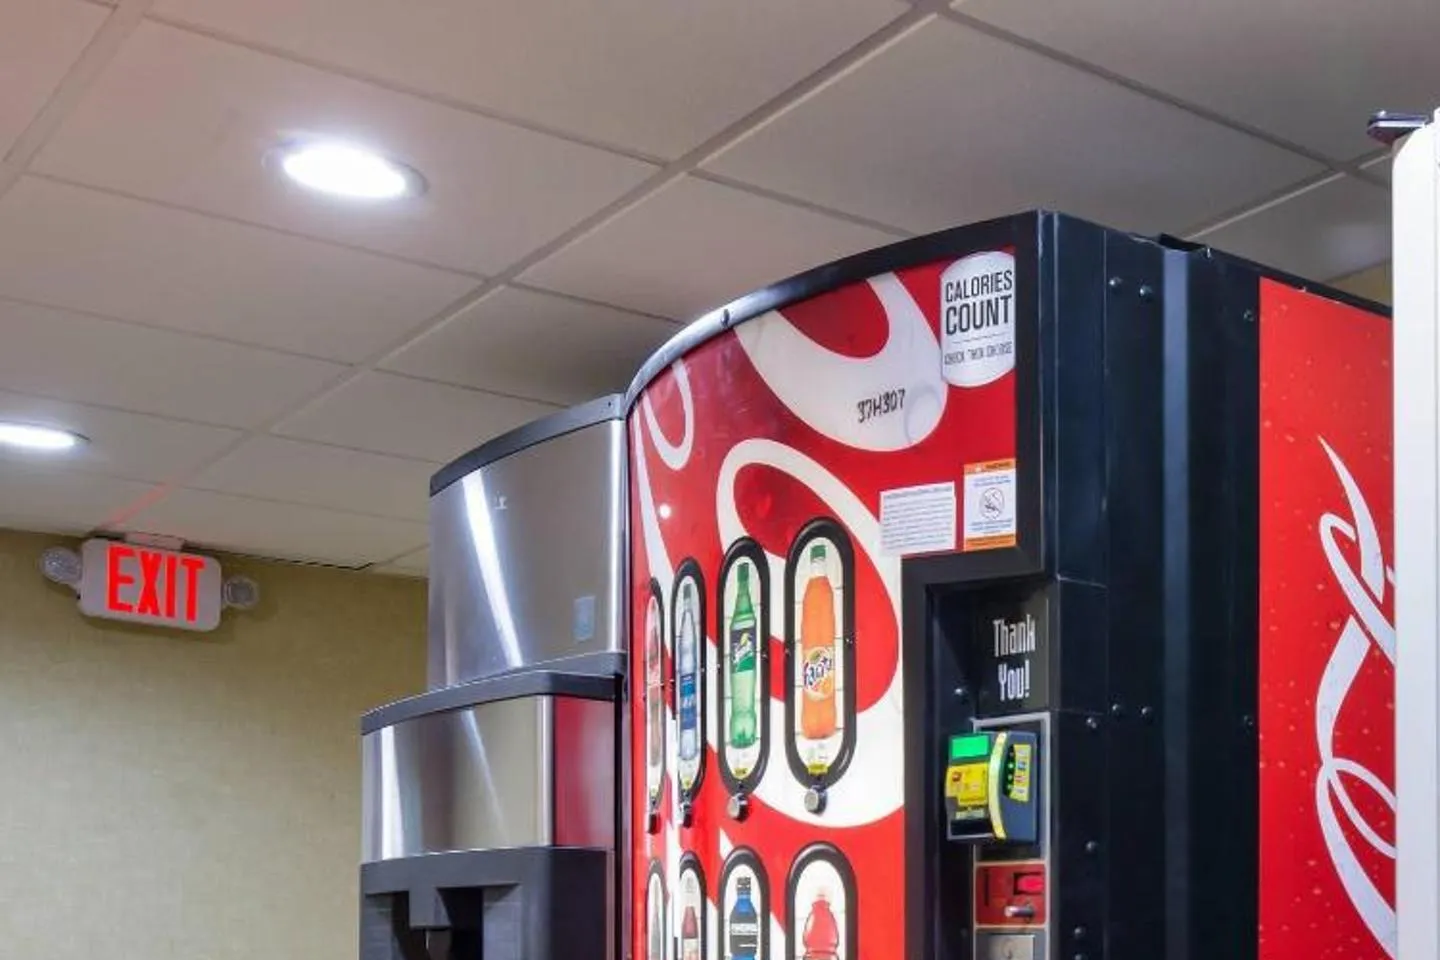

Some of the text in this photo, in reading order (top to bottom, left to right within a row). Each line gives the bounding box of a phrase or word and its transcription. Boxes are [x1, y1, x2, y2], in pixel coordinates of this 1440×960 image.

[945, 270, 1013, 303] CALORIES
[945, 294, 1013, 335] COUNT
[106, 545, 206, 622] EXIT
[993, 614, 1036, 657] Thank
[998, 660, 1031, 702] You!
